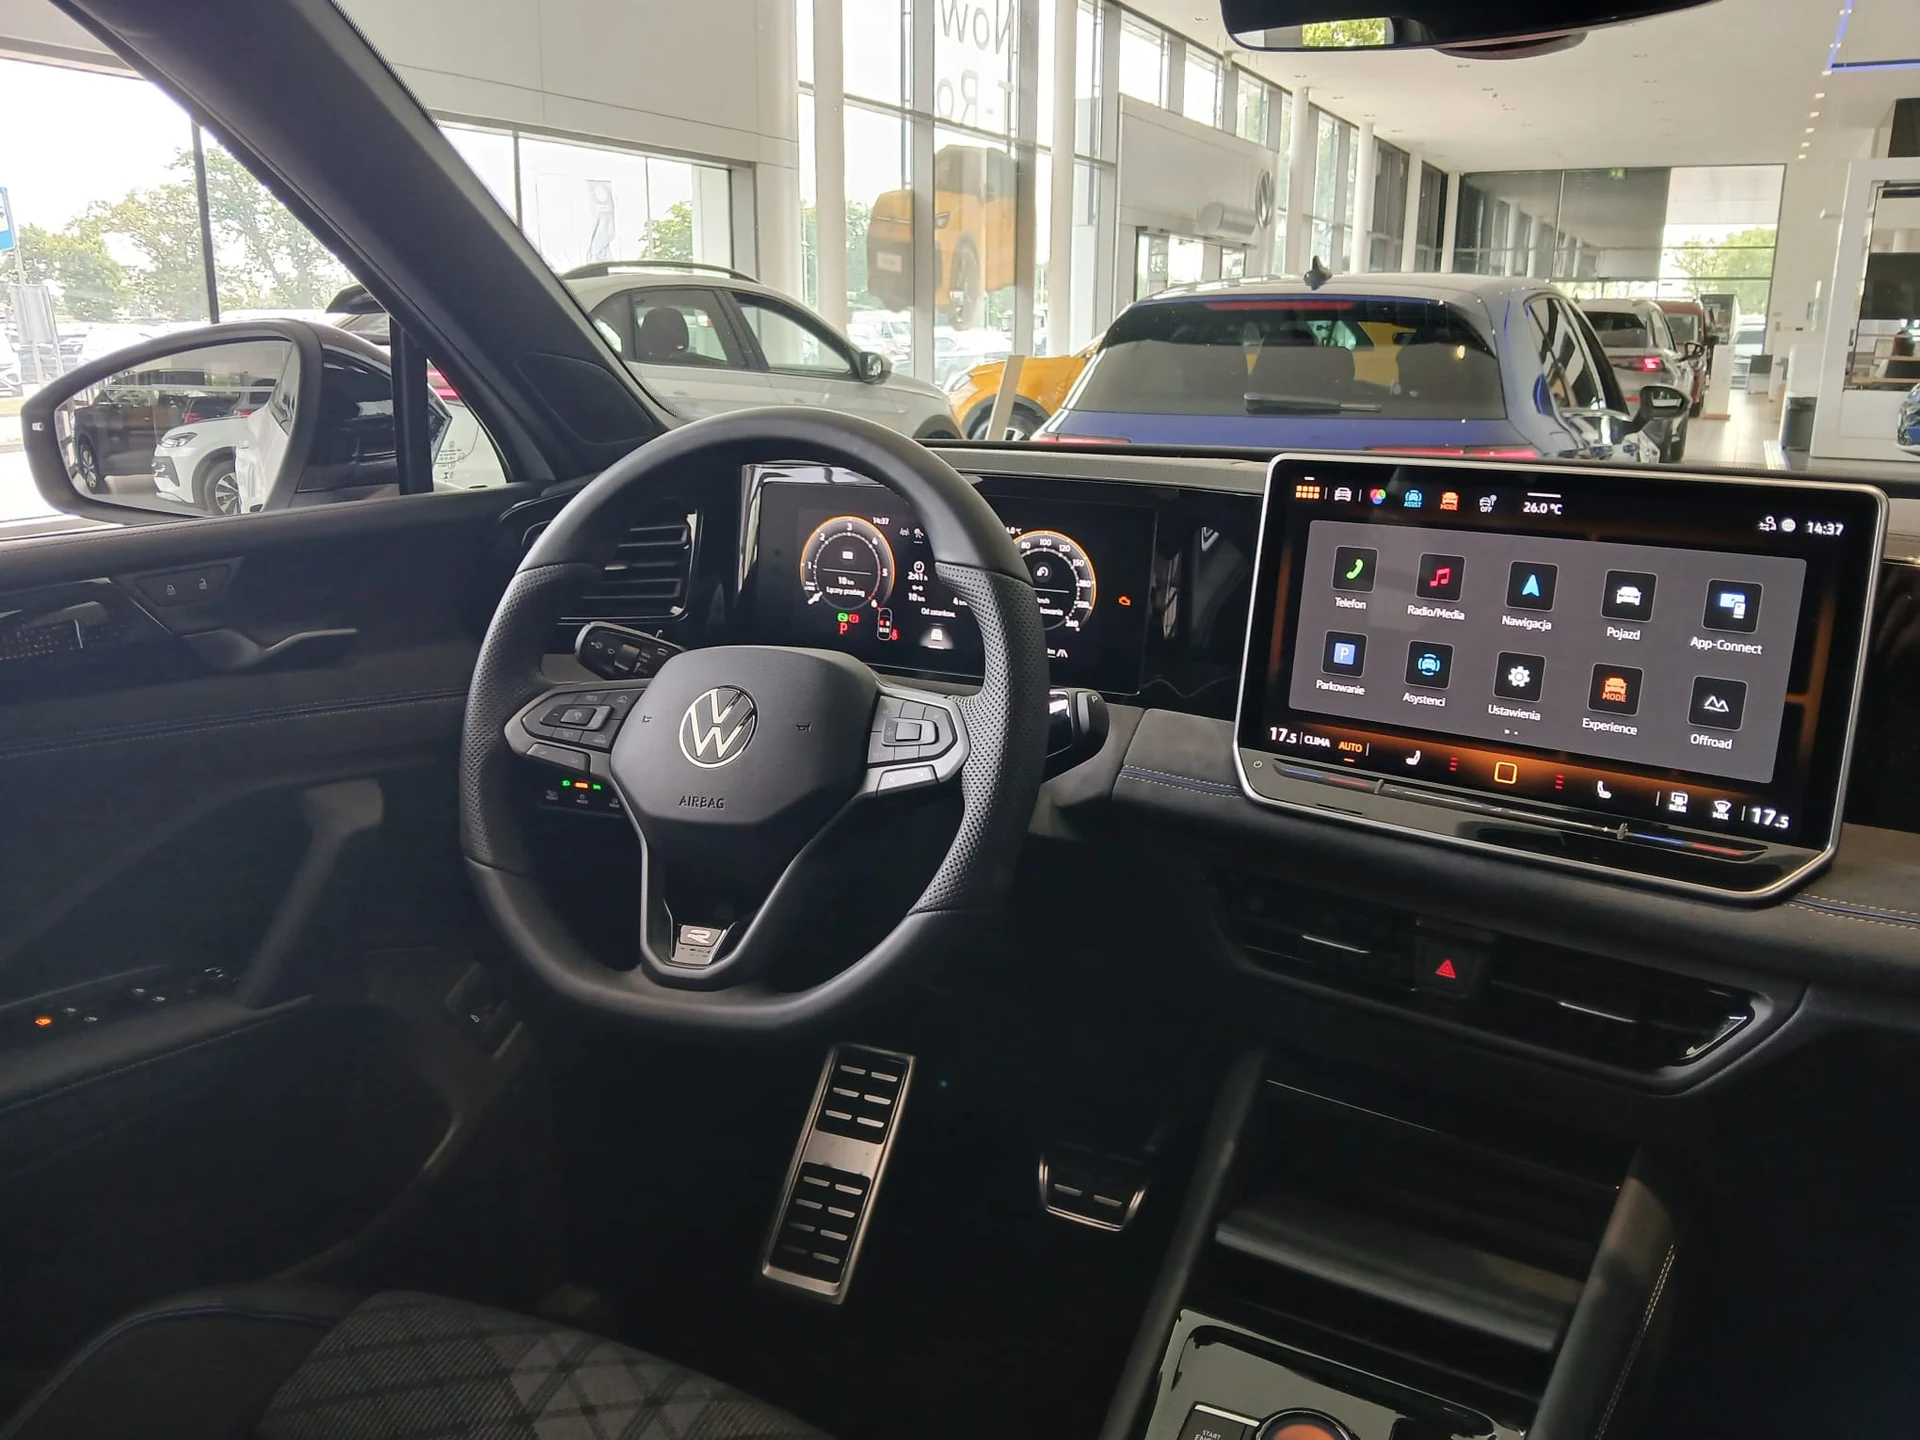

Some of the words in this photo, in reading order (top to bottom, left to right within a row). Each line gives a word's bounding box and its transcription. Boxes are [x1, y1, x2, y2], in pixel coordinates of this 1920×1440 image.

[1523, 501, 1548, 514] 26.0
[1805, 521, 1844, 536] 14:37
[1040, 538, 1052, 547] 100
[1059, 544, 1071, 552] 120
[1072, 559, 1085, 567] 150
[1334, 596, 1367, 610] Telefon
[1407, 604, 1466, 620] Radio/Media
[1501, 615, 1552, 631] Nawigacja
[1606, 626, 1641, 642] Pojazd
[1689, 636, 1763, 655] App-Connect
[1315, 679, 1365, 696] Parkowanie
[1402, 692, 1446, 708] Asystenci
[1601, 691, 1627, 703] MODE
[1487, 704, 1541, 721] Ustawienia
[1581, 717, 1638, 736] Experience
[1269, 727, 1297, 744] 17.5
[1304, 734, 1331, 748] CLIMA
[1338, 741, 1363, 753] AUTO
[1690, 733, 1733, 750] Offroad
[678, 795, 725, 809] AIRBAG
[1712, 811, 1729, 821] MAX
[1750, 807, 1790, 829] 17.5
[1202, 1429, 1221, 1440] START
